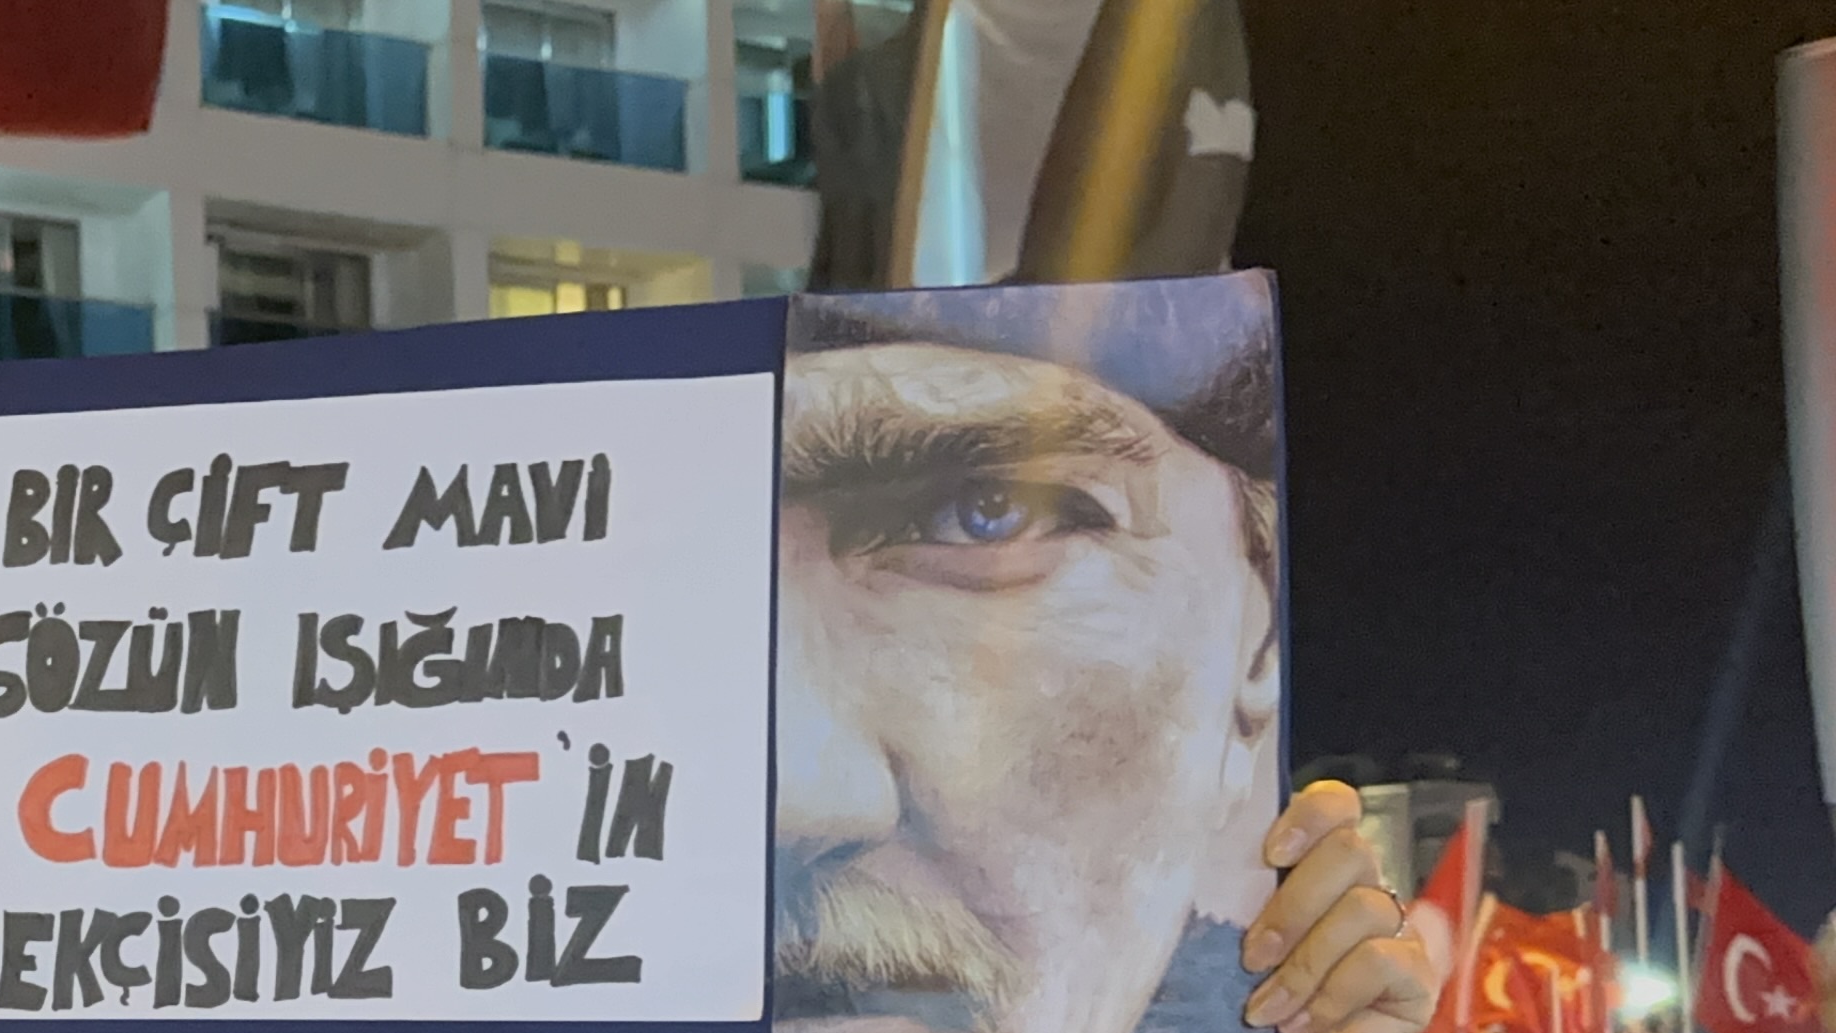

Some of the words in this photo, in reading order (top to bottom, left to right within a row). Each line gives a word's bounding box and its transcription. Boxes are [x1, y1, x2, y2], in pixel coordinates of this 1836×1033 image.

[147, 453, 350, 560] ÇİFT
[382, 452, 611, 551] MAVİ
[292, 606, 624, 715] IŞIĞINDA
[457, 874, 643, 990] BİZ
